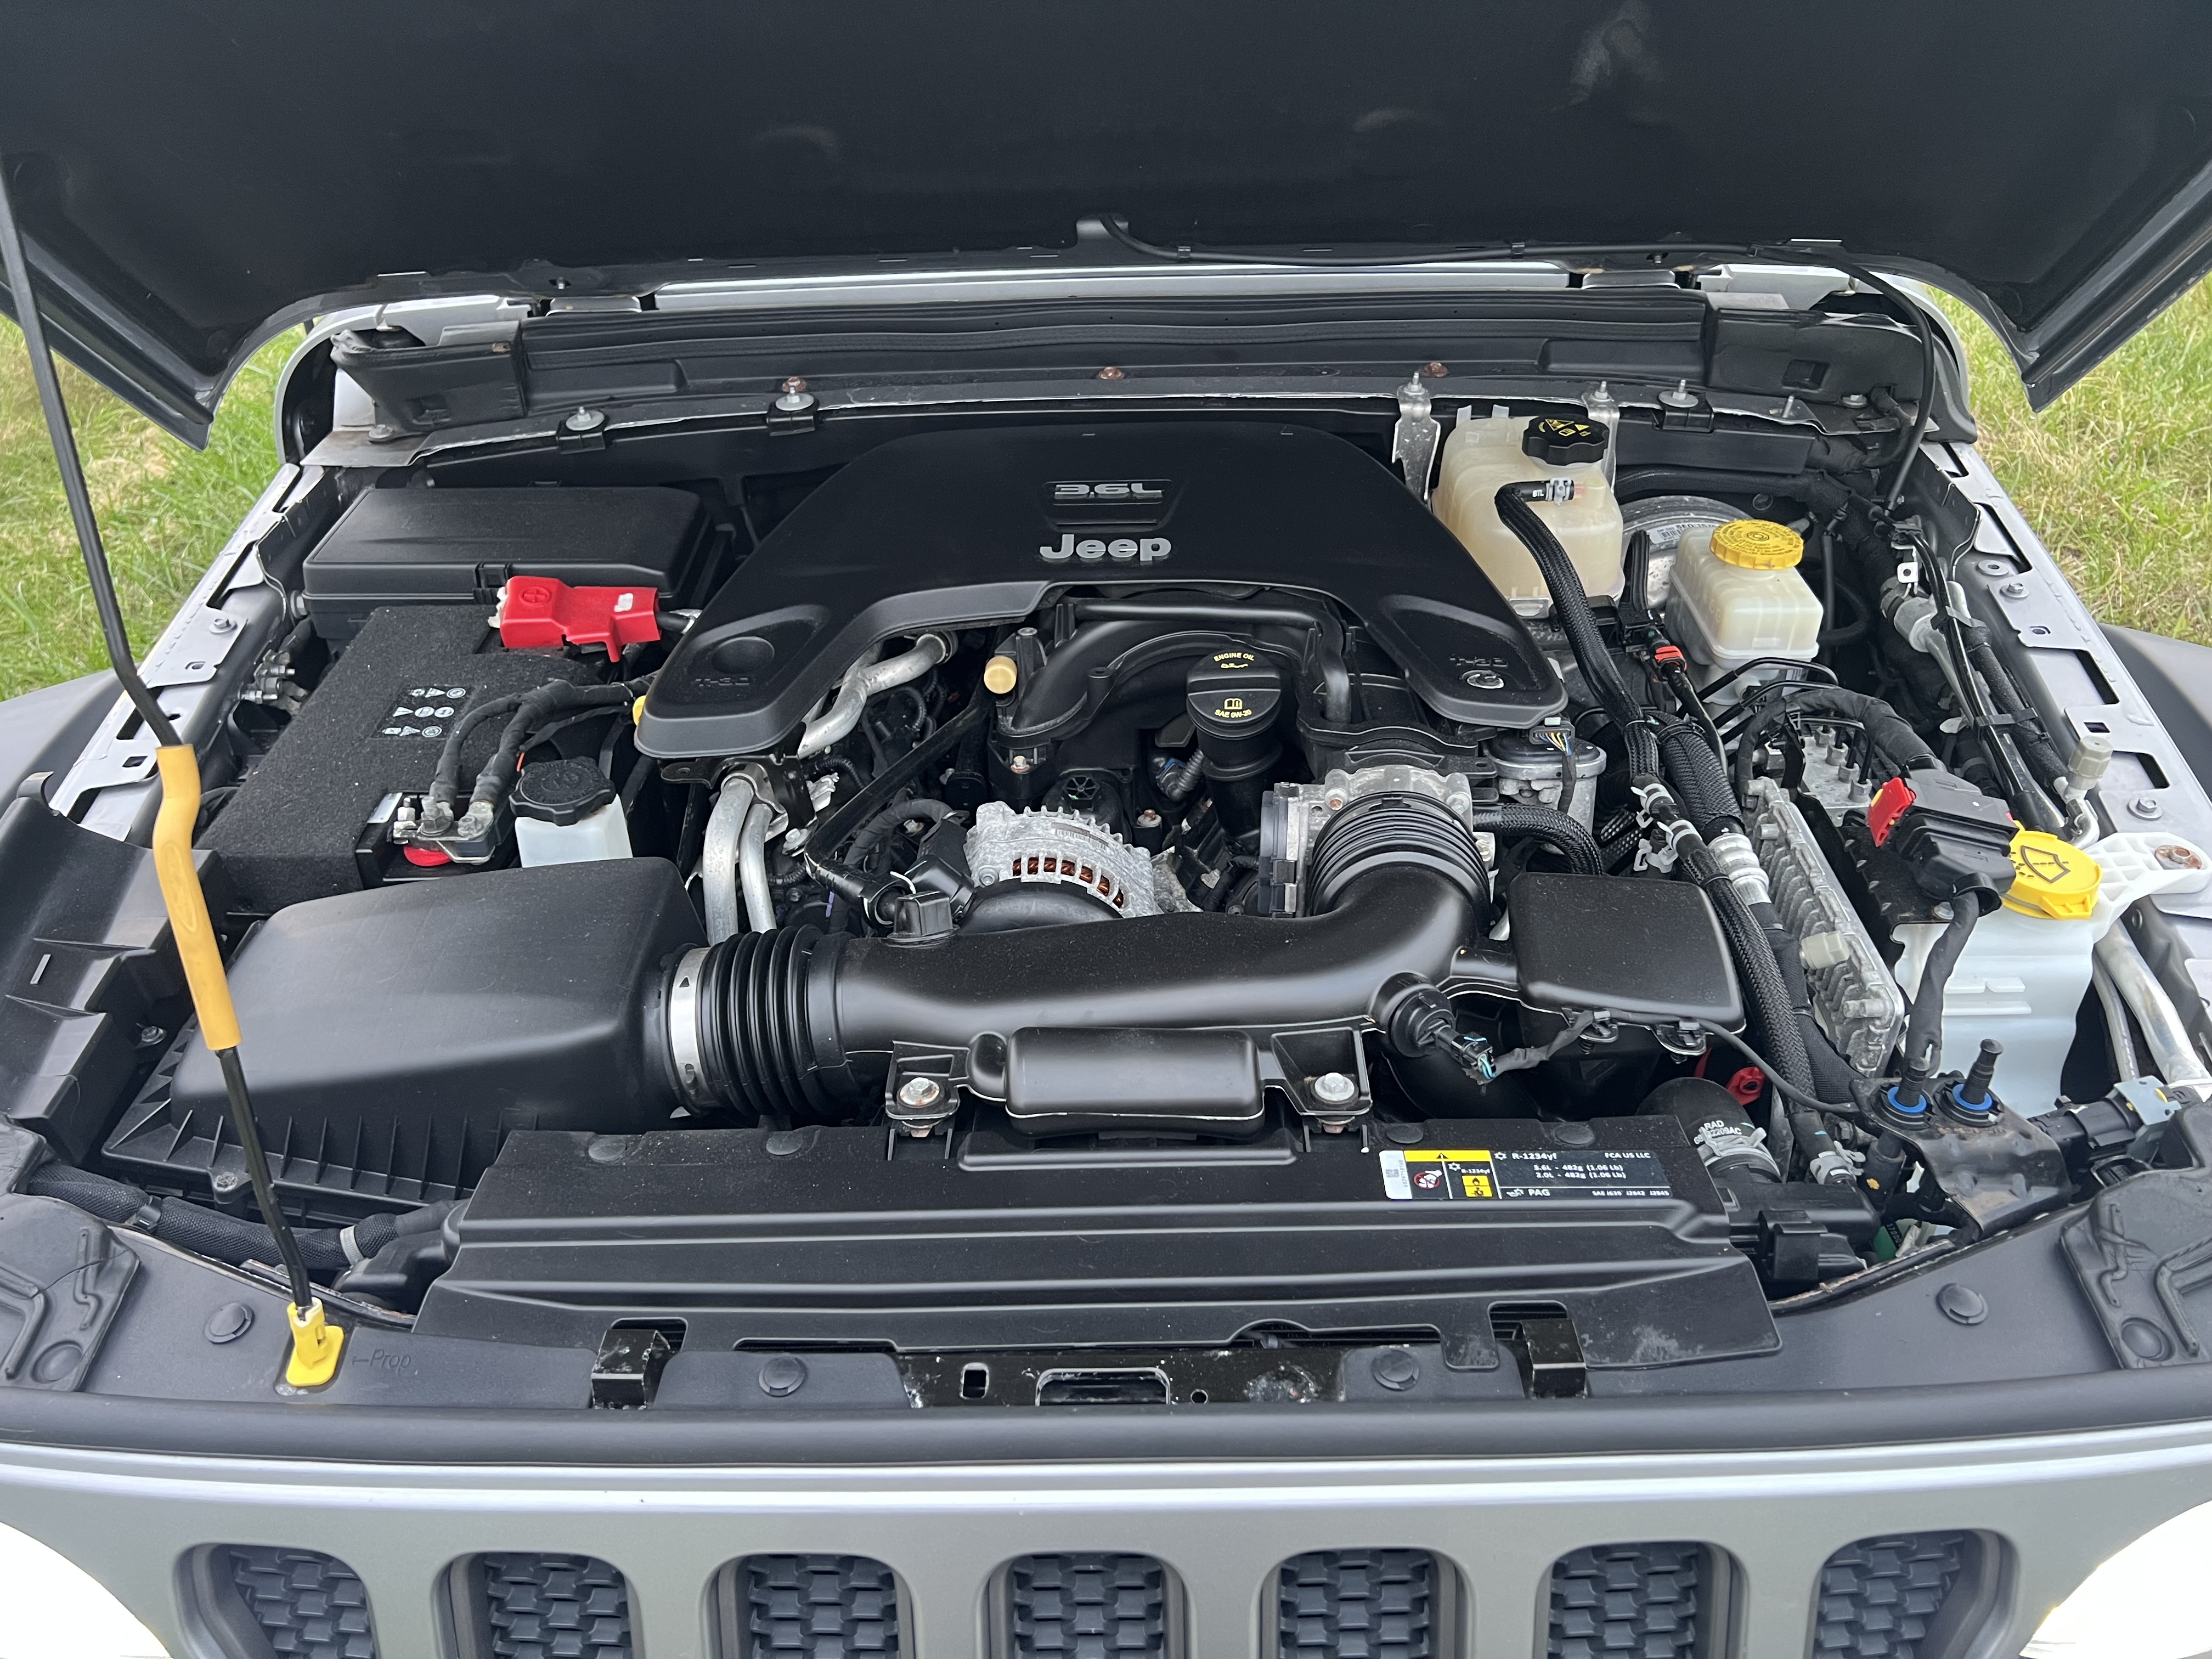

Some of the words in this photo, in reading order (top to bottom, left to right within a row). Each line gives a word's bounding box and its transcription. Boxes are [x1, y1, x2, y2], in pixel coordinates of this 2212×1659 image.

[1054, 483, 1163, 497] 3.6L
[1532, 489, 1544, 498] BTL
[1040, 534, 1171, 562] Jeep
[1214, 652, 1242, 662] ENGINE
[1243, 652, 1255, 661] OIL
[1214, 709, 1230, 718] SAE
[1231, 709, 1252, 718] 0W-20
[1703, 1120, 1725, 1130] RAD
[1511, 1152, 1558, 1161] R-1234yf
[369, 1348, 411, 1374] Prop
